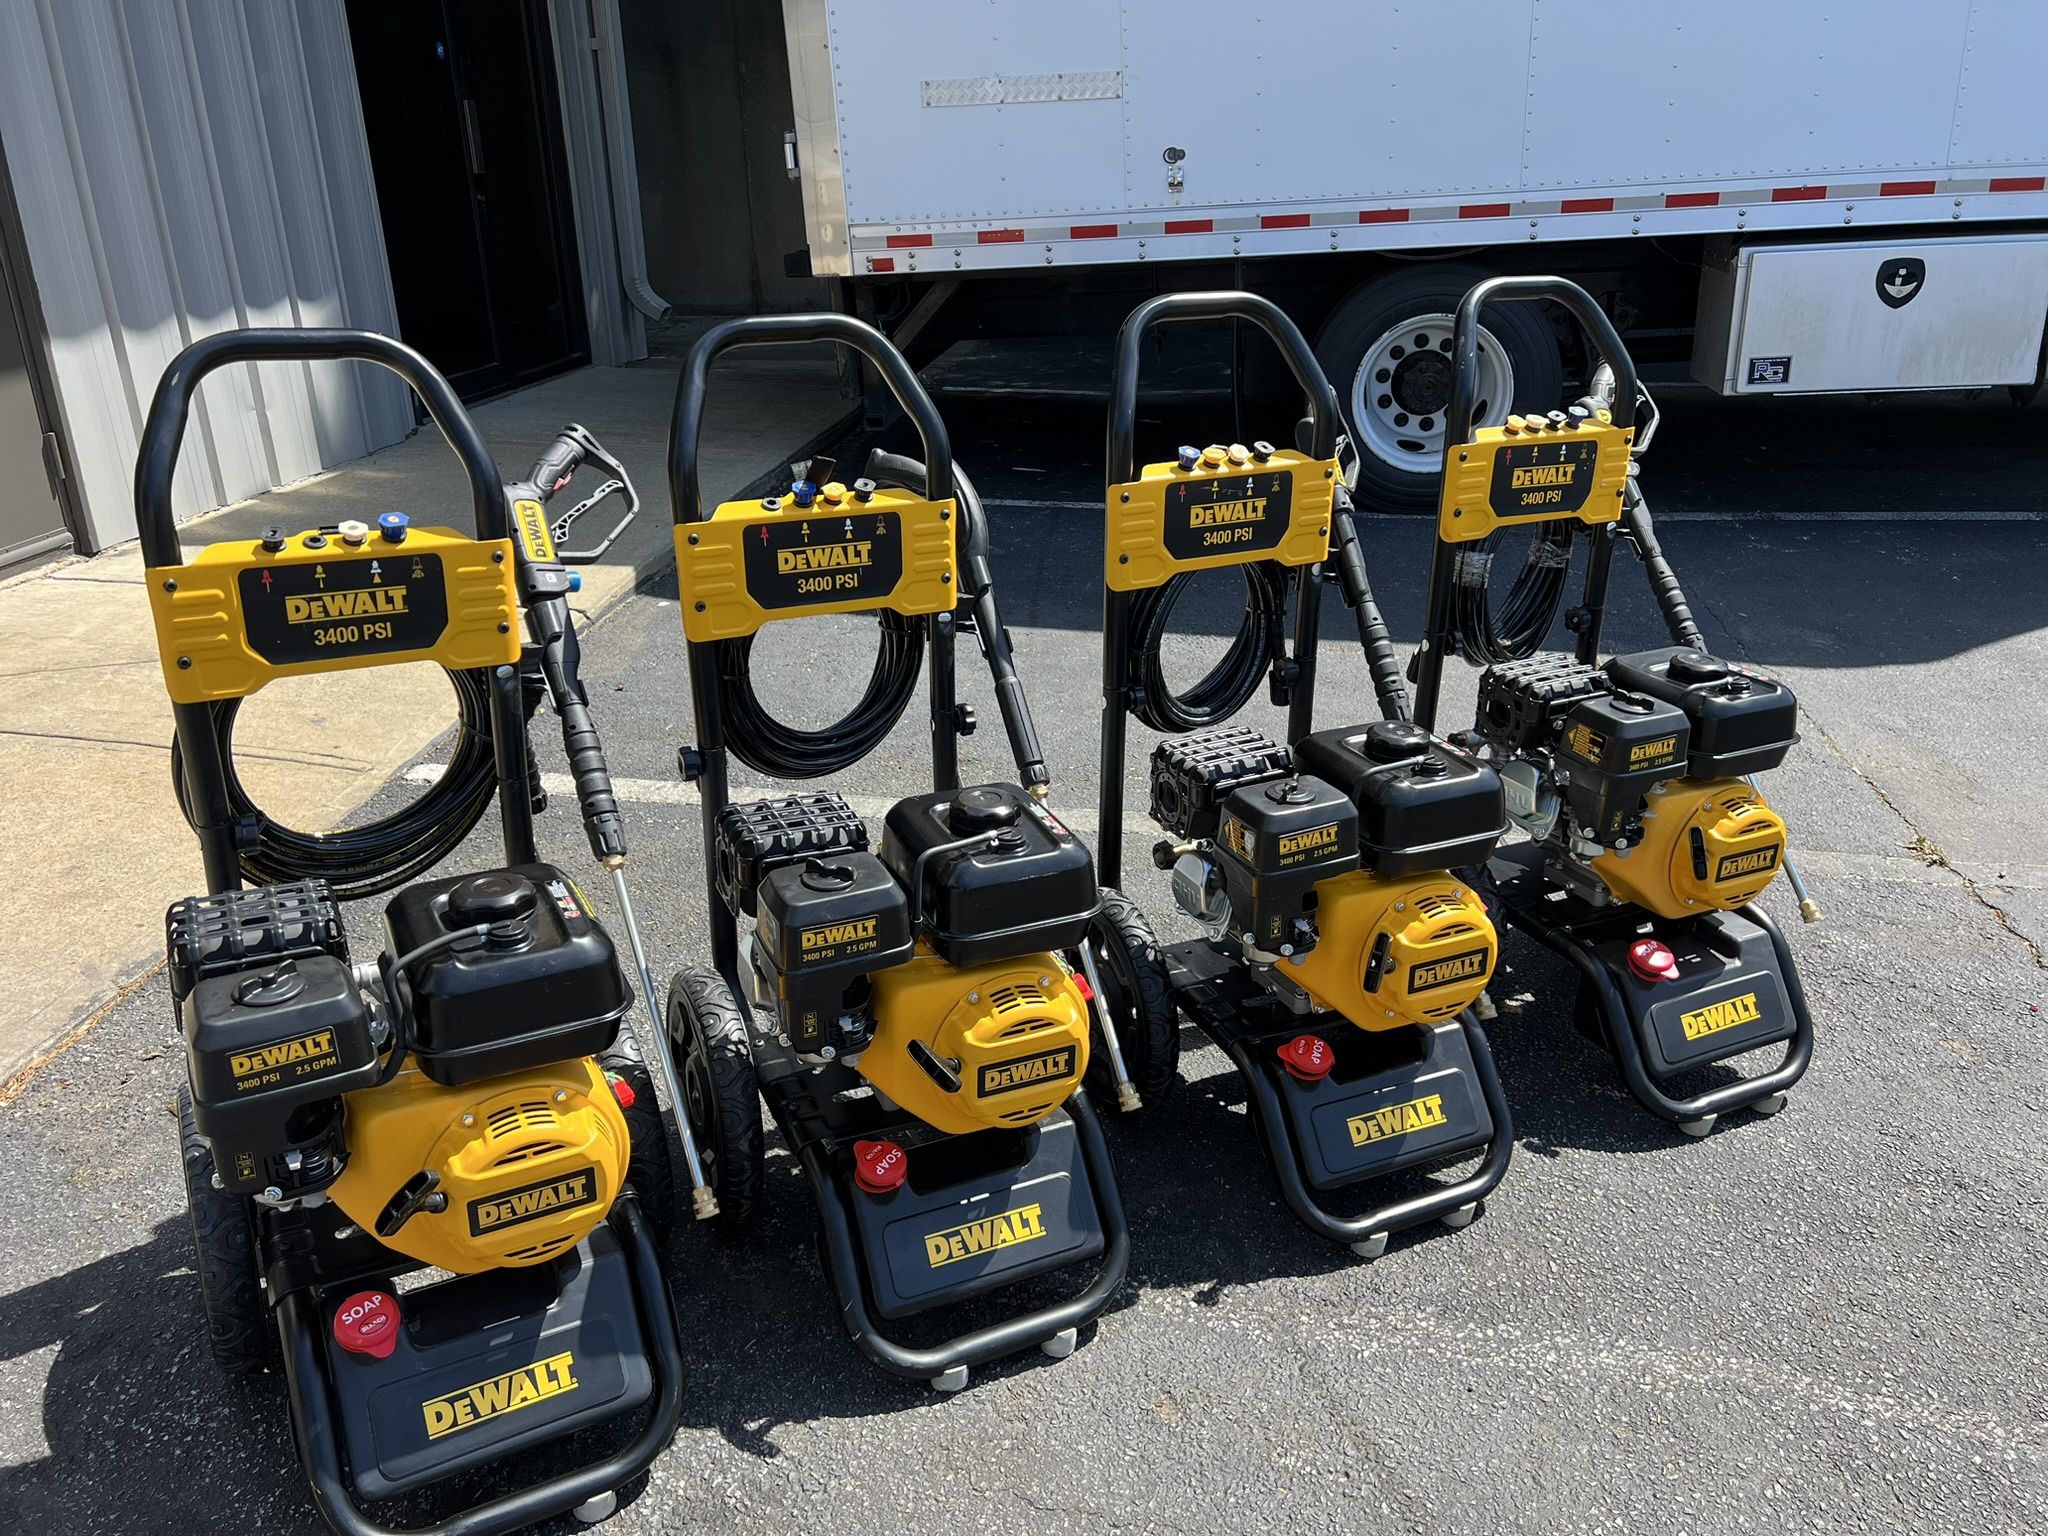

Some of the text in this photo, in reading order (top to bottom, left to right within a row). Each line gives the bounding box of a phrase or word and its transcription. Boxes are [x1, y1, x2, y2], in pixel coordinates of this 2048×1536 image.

[1521, 490, 1562, 505] 3400 PSI
[1203, 527, 1253, 546] 3400 PSI
[797, 573, 858, 593] 3400 PSI
[314, 622, 392, 646] 3400 PSI
[1280, 856, 1294, 866] 3400
[1294, 853, 1305, 863] PSI
[1323, 844, 1338, 855] GPM
[802, 940, 877, 962] 3400 PSI 2.5 GPM
[1636, 940, 1657, 956] OAP
[1311, 1039, 1324, 1064] SOAP
[237, 1056, 337, 1091] 3400 PSI 2.5 GPM
[876, 1148, 901, 1175] SOAP
[341, 1294, 382, 1325] SOAP
